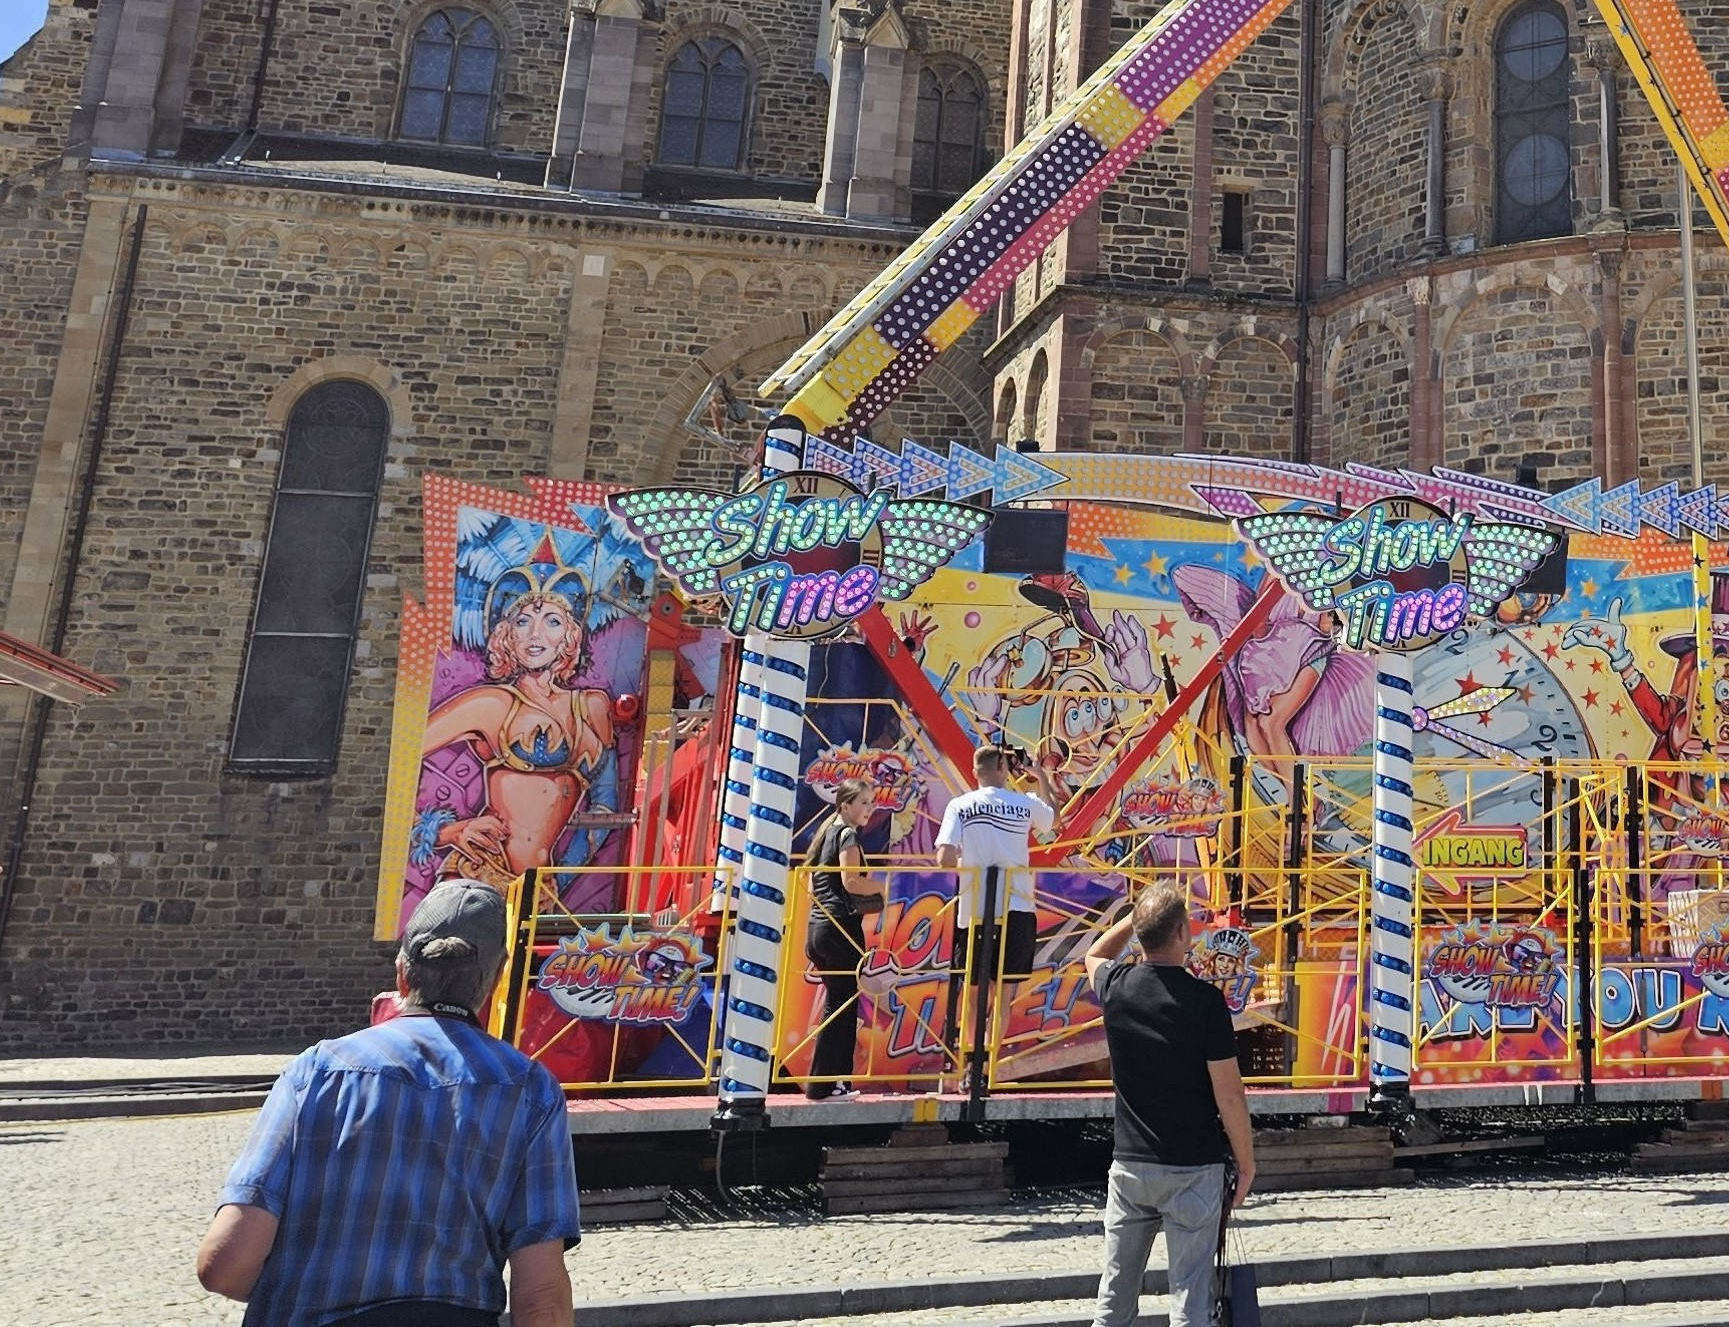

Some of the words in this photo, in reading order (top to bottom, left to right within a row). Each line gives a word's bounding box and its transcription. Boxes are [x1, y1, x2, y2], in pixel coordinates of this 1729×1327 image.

[702, 480, 895, 567] Show
[1319, 506, 1476, 586] Show
[722, 562, 879, 638] Time
[1335, 580, 1468, 650] Time
[805, 759, 871, 785] SHOW
[1124, 791, 1178, 817] SHOW
[1422, 837, 1525, 867] INGANG
[540, 951, 630, 990] SHOW
[1431, 944, 1500, 977] SHOW
[607, 983, 696, 1021] TIME!
[1486, 973, 1558, 1008] TIME!
[433, 1002, 469, 1018] Canon
